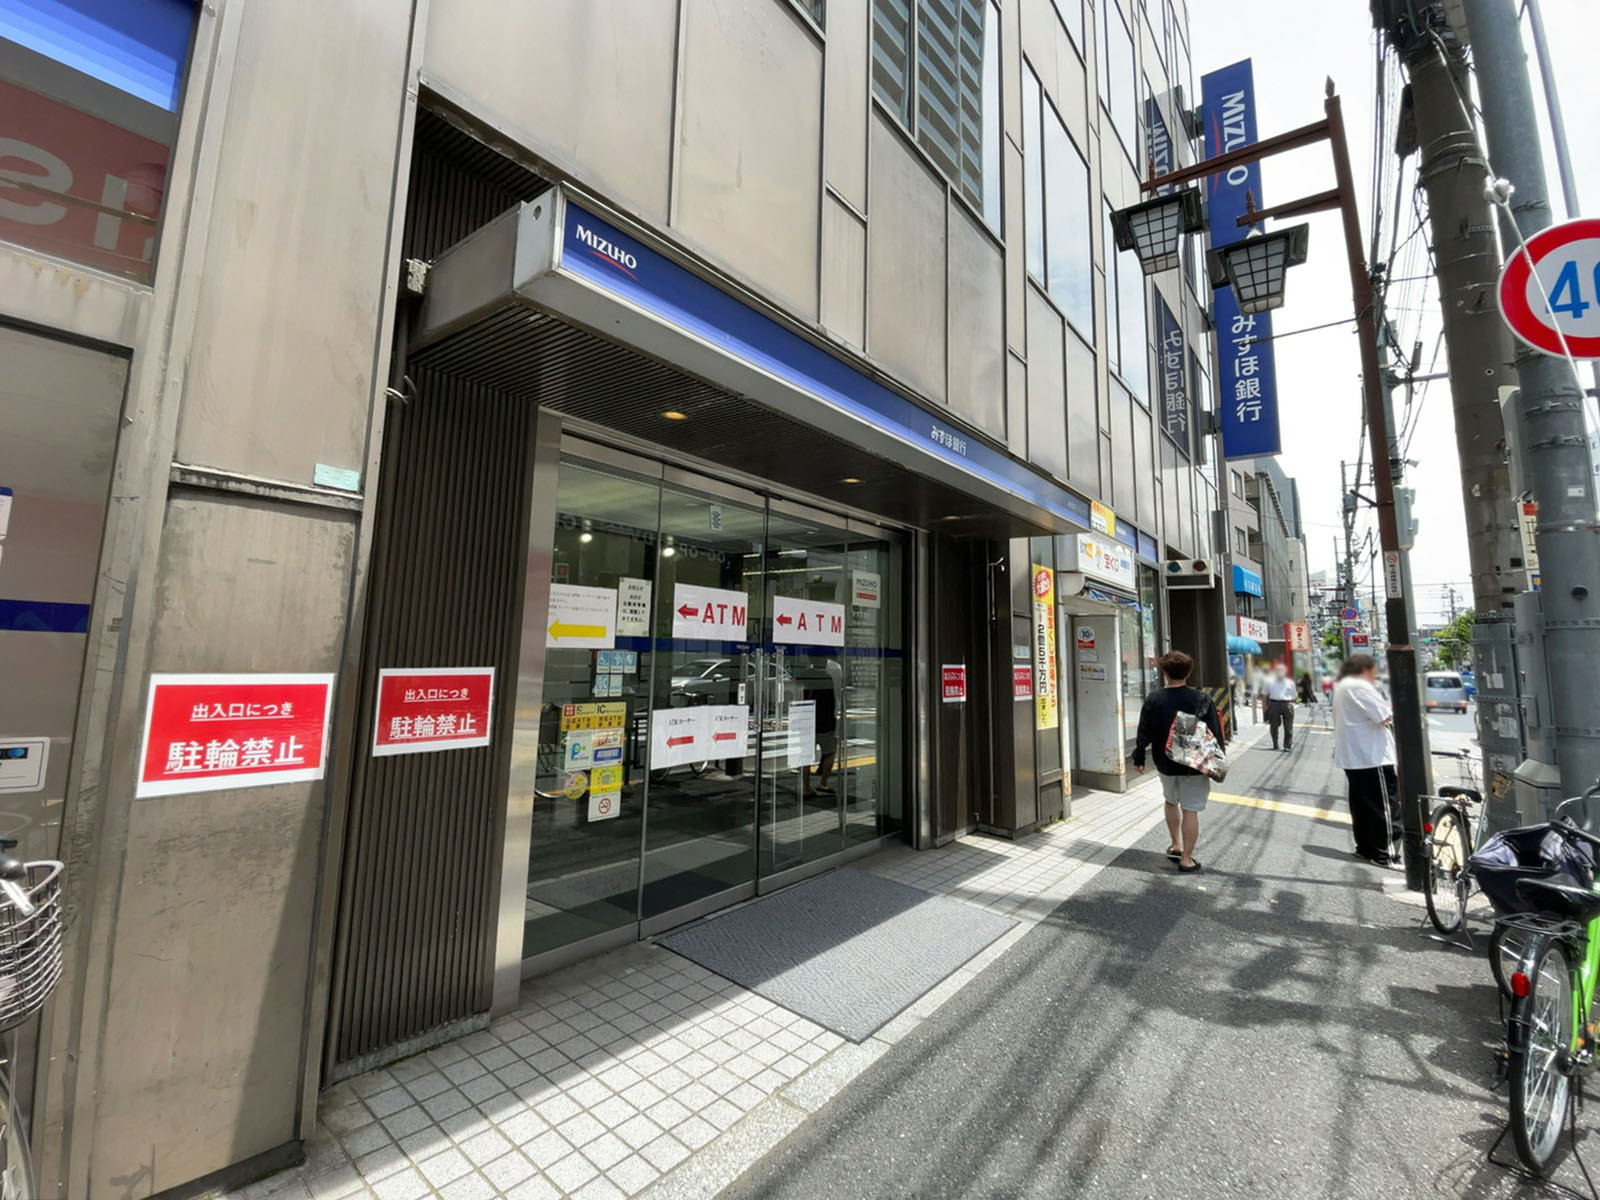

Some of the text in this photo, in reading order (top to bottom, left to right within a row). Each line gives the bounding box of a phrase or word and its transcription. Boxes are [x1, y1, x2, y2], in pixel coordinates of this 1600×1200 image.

[1221, 90, 1249, 186] MIZUO
[576, 224, 637, 269] MIZUHO
[1545, 260, 1600, 319] 4
[1231, 314, 1262, 423] みずほ銀行
[931, 425, 967, 456] みずほ銀行
[702, 602, 745, 626] ATM
[191, 702, 293, 719] 出入口につき
[404, 688, 469, 700] 出入口につき
[390, 713, 477, 739] 駐輪禁止
[165, 735, 304, 772] 駐輪禁止
